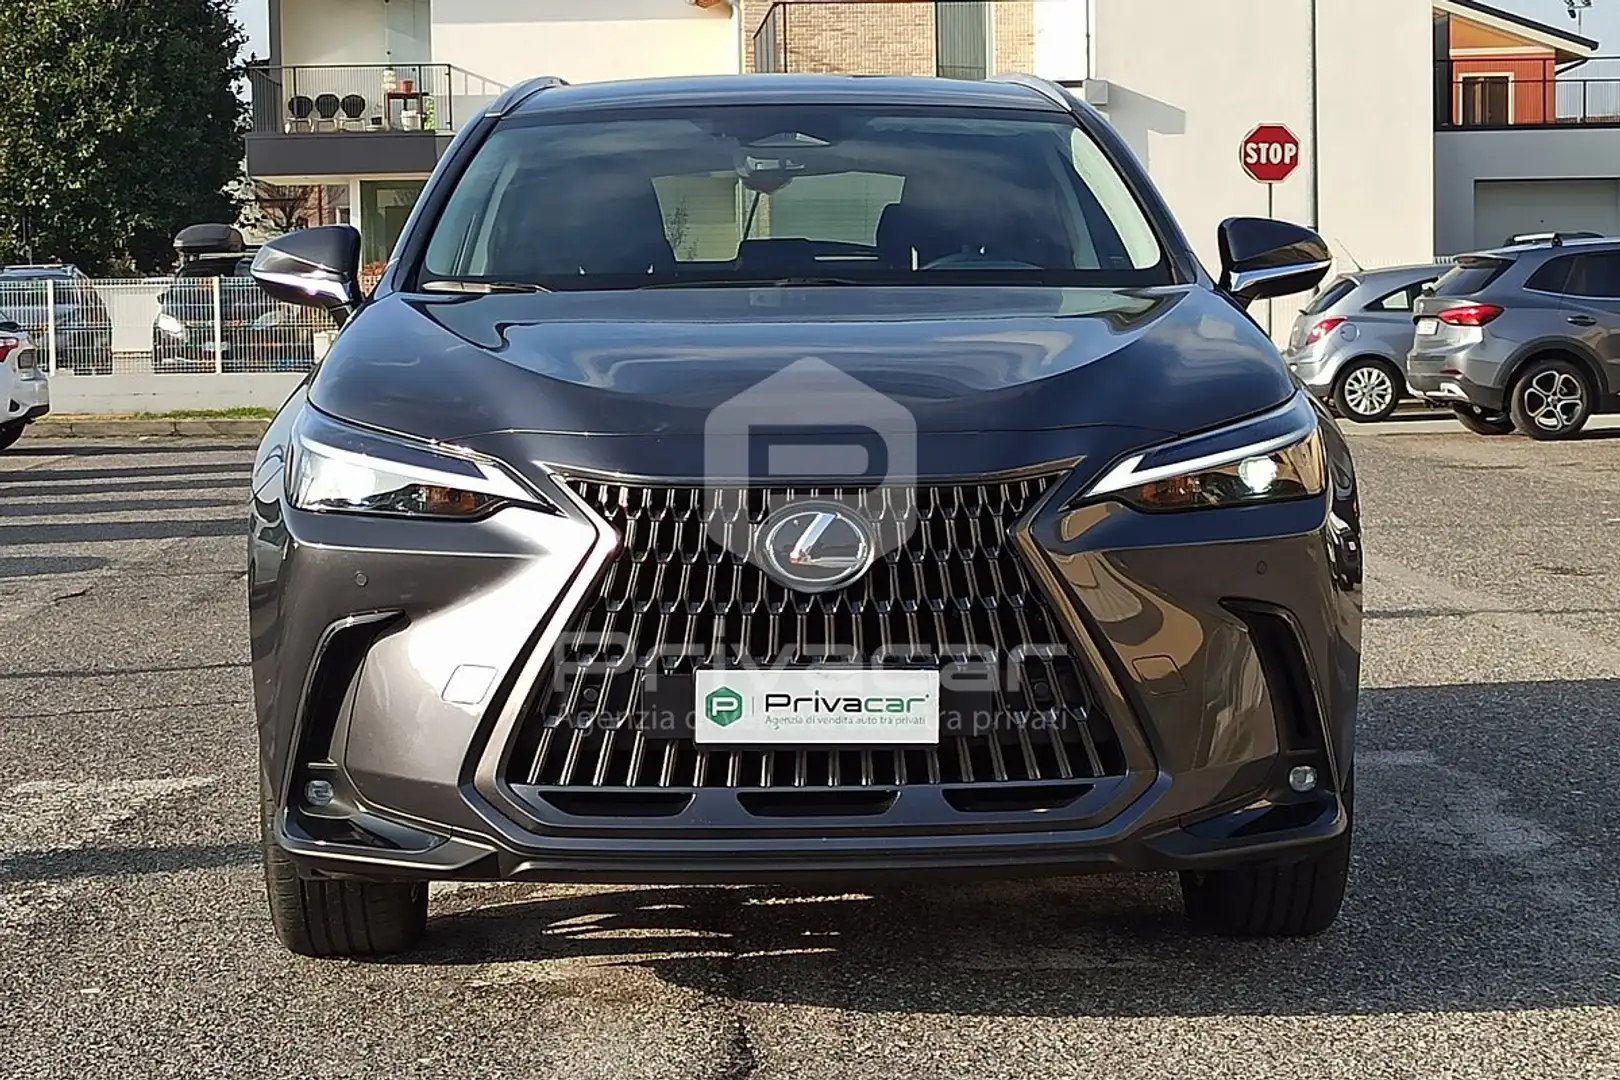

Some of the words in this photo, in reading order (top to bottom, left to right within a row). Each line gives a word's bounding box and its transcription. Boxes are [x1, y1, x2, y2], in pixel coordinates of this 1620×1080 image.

[1245, 142, 1297, 165] STOP
[766, 689, 927, 713] Privacar
[765, 715, 803, 728] Agenzia
[806, 715, 816, 725] di
[817, 715, 853, 725] vendita
[855, 715, 878, 725] auto
[880, 715, 893, 725] tra
[895, 715, 926, 727] privati
